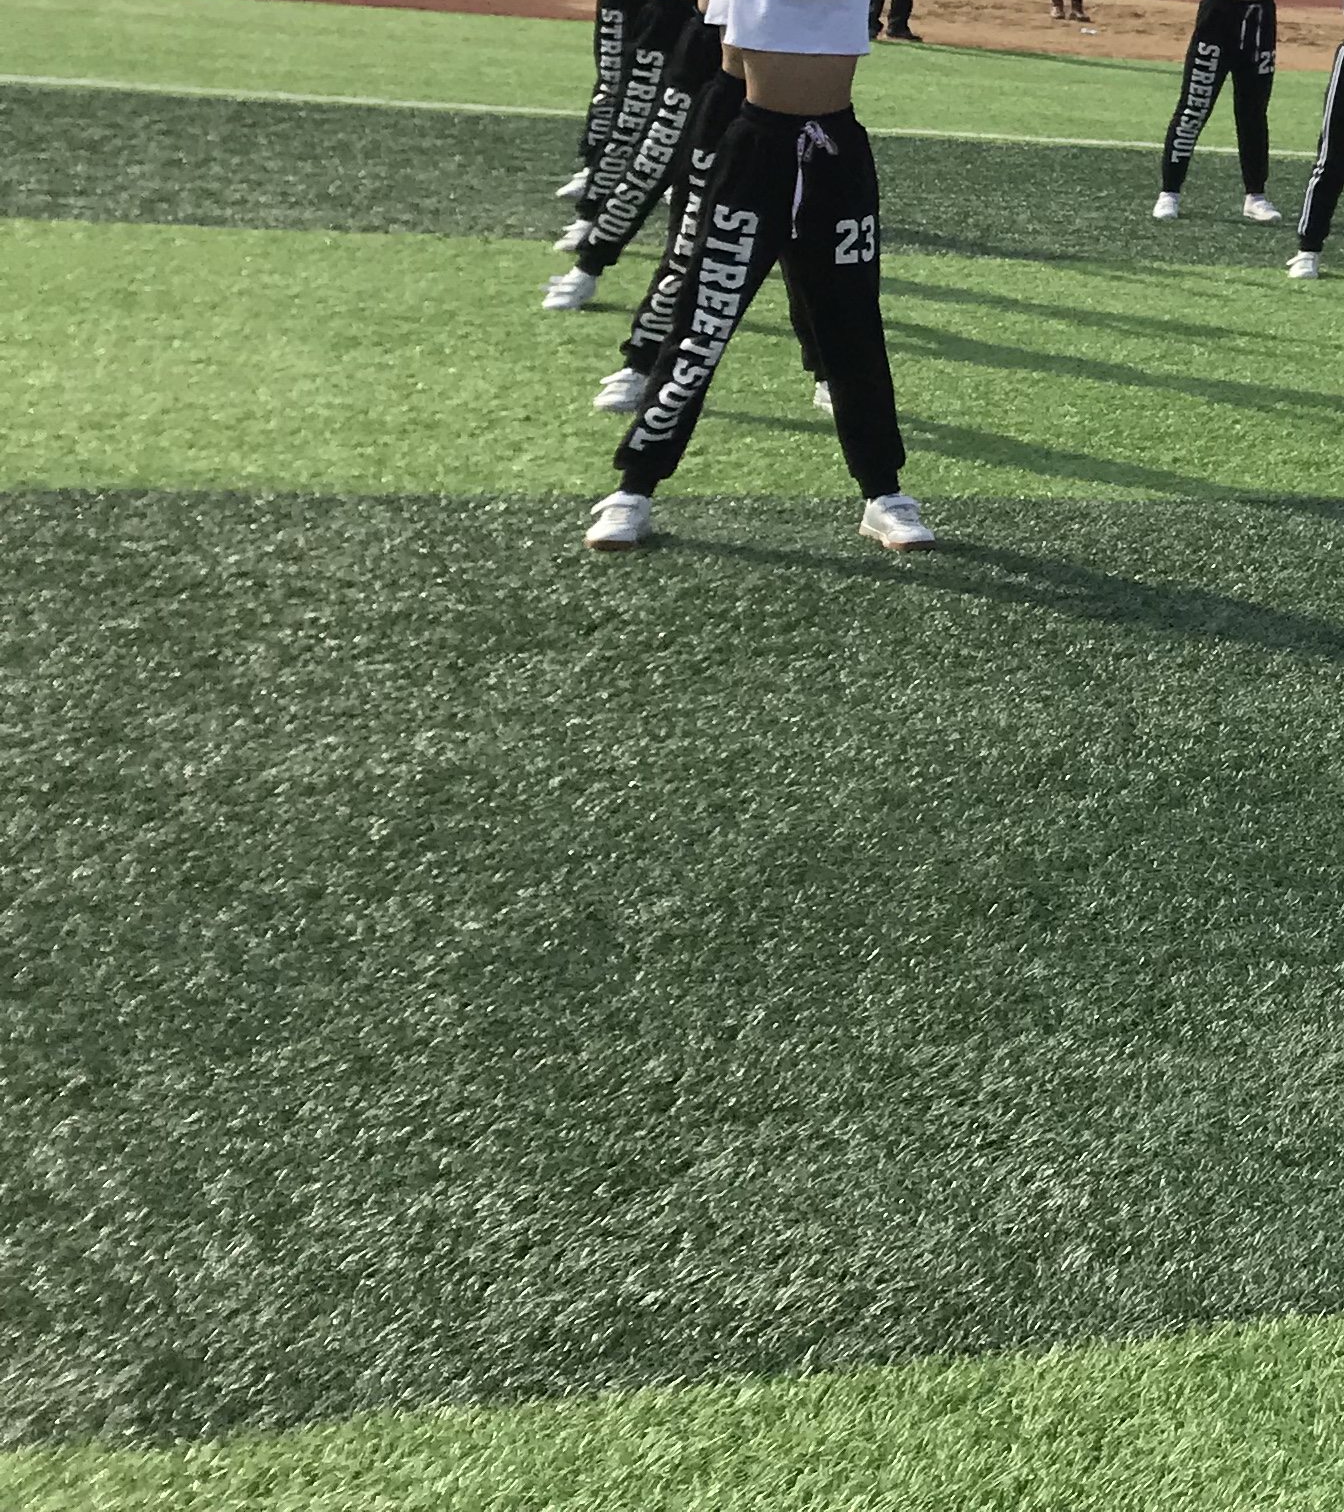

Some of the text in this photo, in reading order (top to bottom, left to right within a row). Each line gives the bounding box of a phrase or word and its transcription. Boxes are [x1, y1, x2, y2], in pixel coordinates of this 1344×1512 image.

[588, 48, 666, 200] STREETSOUL
[588, 88, 691, 245] STREETSOUL
[1171, 41, 1220, 164] STREETSOUL
[835, 215, 875, 264] 23
[629, 204, 760, 451] STREETSOUL
